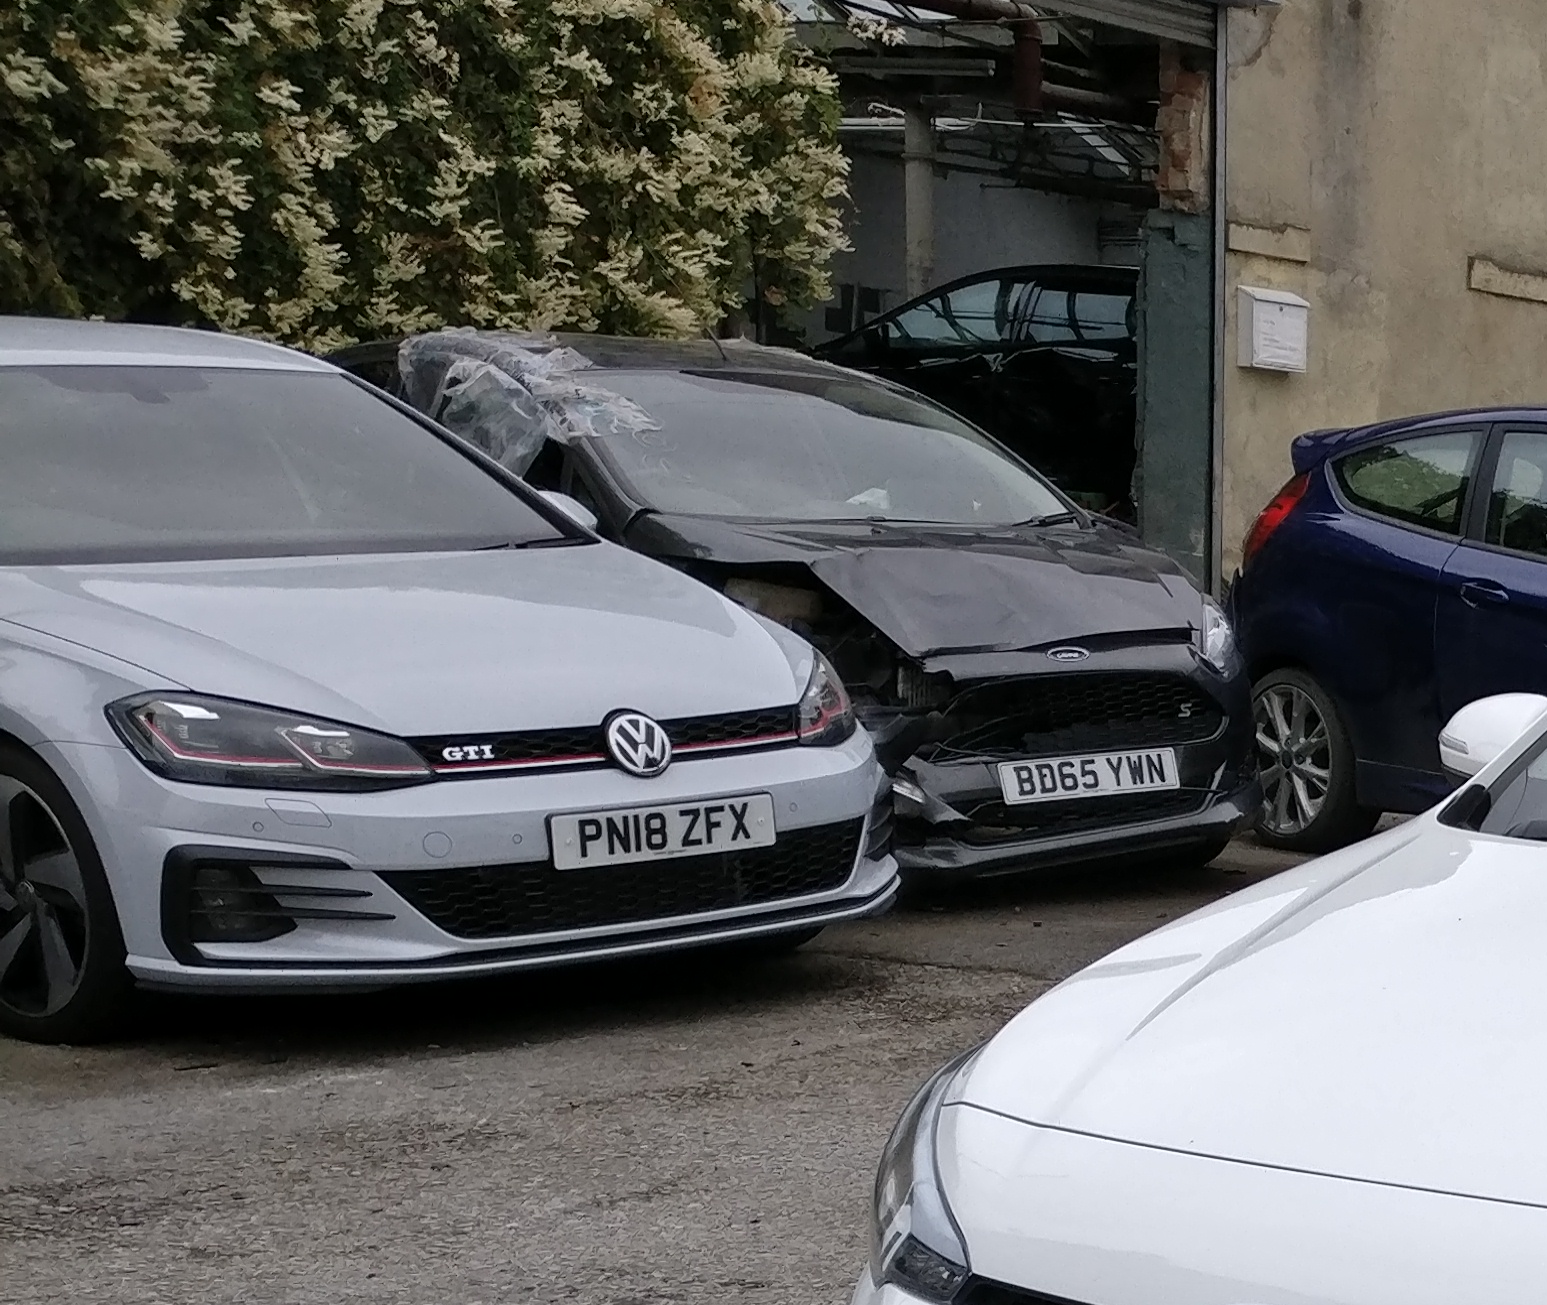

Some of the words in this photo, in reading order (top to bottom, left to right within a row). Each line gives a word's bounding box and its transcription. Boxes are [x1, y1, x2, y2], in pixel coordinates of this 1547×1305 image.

[442, 744, 495, 762] GTI
[1013, 758, 1100, 797] BD65
[1105, 753, 1167, 787] YWN
[577, 812, 668, 859] PN18
[679, 802, 751, 848] ZFX
